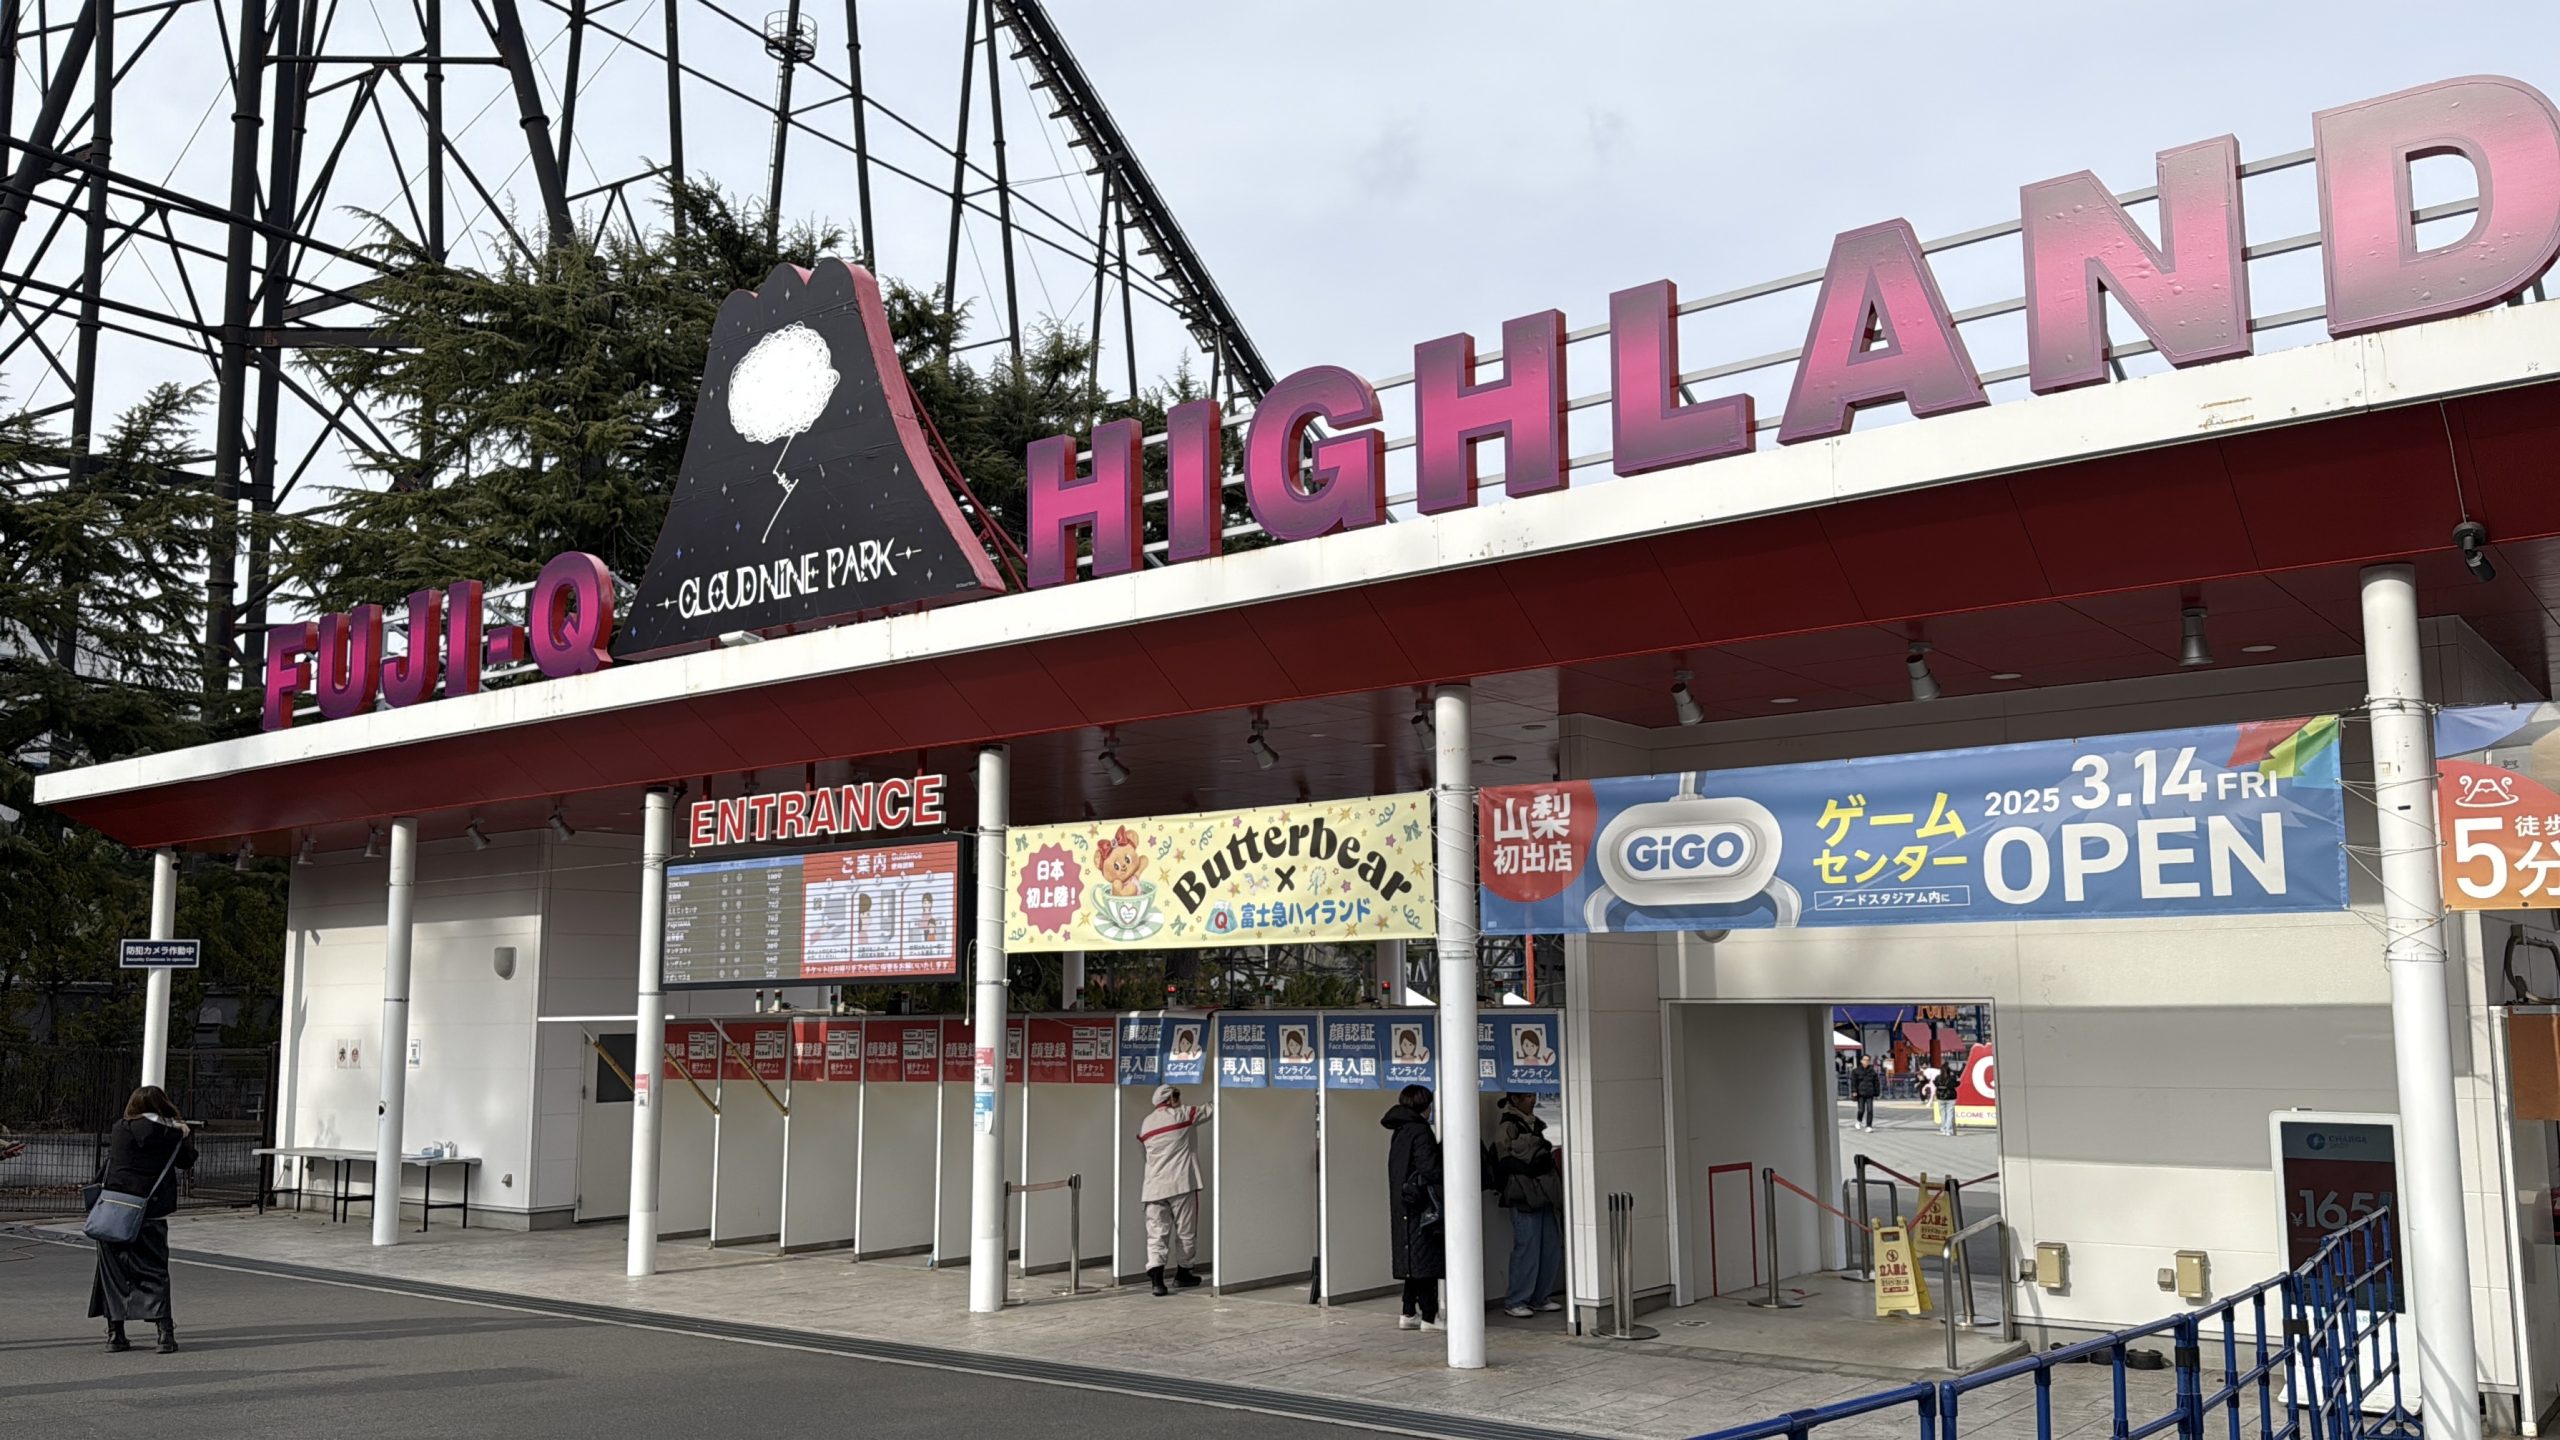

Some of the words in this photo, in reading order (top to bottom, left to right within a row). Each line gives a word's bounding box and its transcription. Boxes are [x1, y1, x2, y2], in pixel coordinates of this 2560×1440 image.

[1025, 73, 2560, 589] HIGHLAND
[826, 537, 898, 588] PARK
[262, 551, 614, 732] FUJI-Q
[1984, 788, 2060, 817] 2025
[2071, 747, 2207, 810] 3.14
[2217, 770, 2278, 801] FRI
[689, 774, 945, 848] ENTRANCE
[1494, 793, 1571, 842] 山梨
[1816, 792, 1968, 847] ゲーム
[841, 854, 887, 875] ご案内
[1493, 841, 1573, 875] 初出店
[1626, 831, 1744, 872] GiGO
[1813, 845, 1967, 884] センター
[1983, 812, 2287, 905] OPEN
[1037, 859, 1065, 881] 日本
[1172, 817, 1412, 915] Butterbear
[1833, 891, 1950, 907] フードスタジアム内に
[1214, 911, 1228, 930] Q
[1241, 898, 1371, 929] 富士急ハイランド
[1223, 1025, 1265, 1042] 顔認証
[1329, 1023, 1375, 1042] 顔認証
[1120, 1056, 1158, 1073] 再入園
[1167, 1063, 1196, 1071] オンライン
[1223, 1057, 1265, 1075] 再入園
[1278, 1066, 1312, 1074] オンライン
[1329, 1058, 1376, 1076] 再入園
[1390, 1067, 1426, 1076] オンライン
[1512, 1068, 1552, 1078] オンライン
